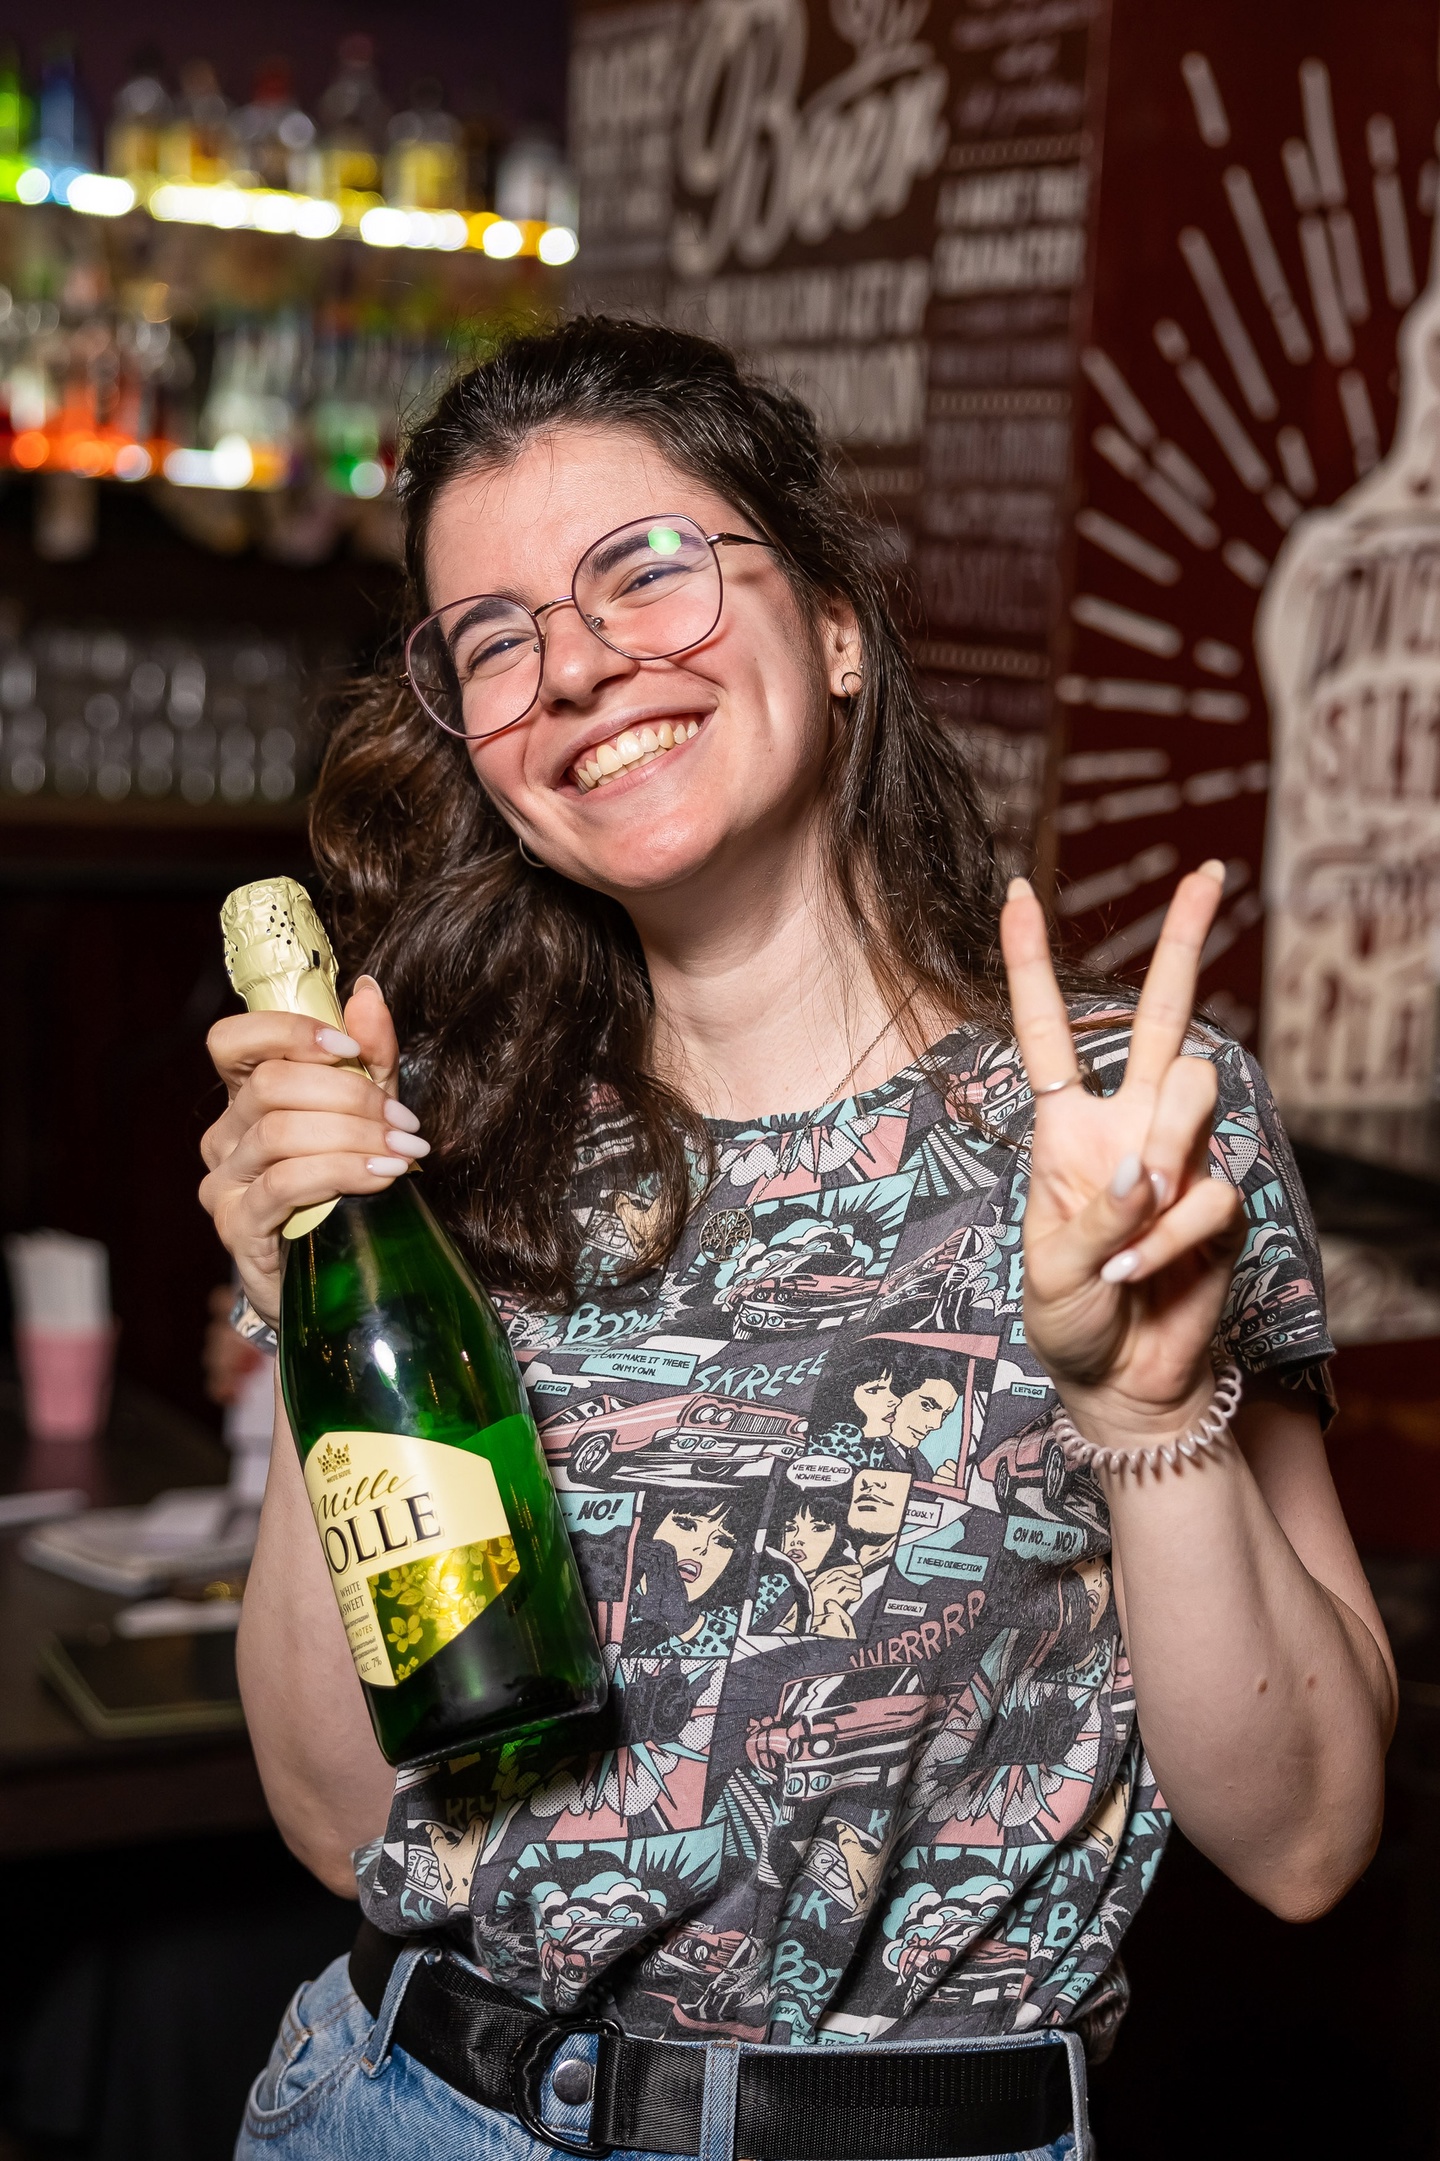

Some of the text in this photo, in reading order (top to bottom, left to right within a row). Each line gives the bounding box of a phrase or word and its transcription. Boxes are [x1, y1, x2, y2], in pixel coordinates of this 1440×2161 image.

[622, 1353, 647, 1363] MAKE
[647, 1356, 660, 1364] IT
[662, 1358, 690, 1369] THERE
[817, 1465, 851, 1474] HEADED
[312, 1469, 418, 1520] Mille
[577, 1498, 625, 1521] NO!
[324, 1491, 443, 1575] OLLE
[340, 1580, 362, 1598] WHITE
[887, 1603, 924, 1613] SERIOUSLY
